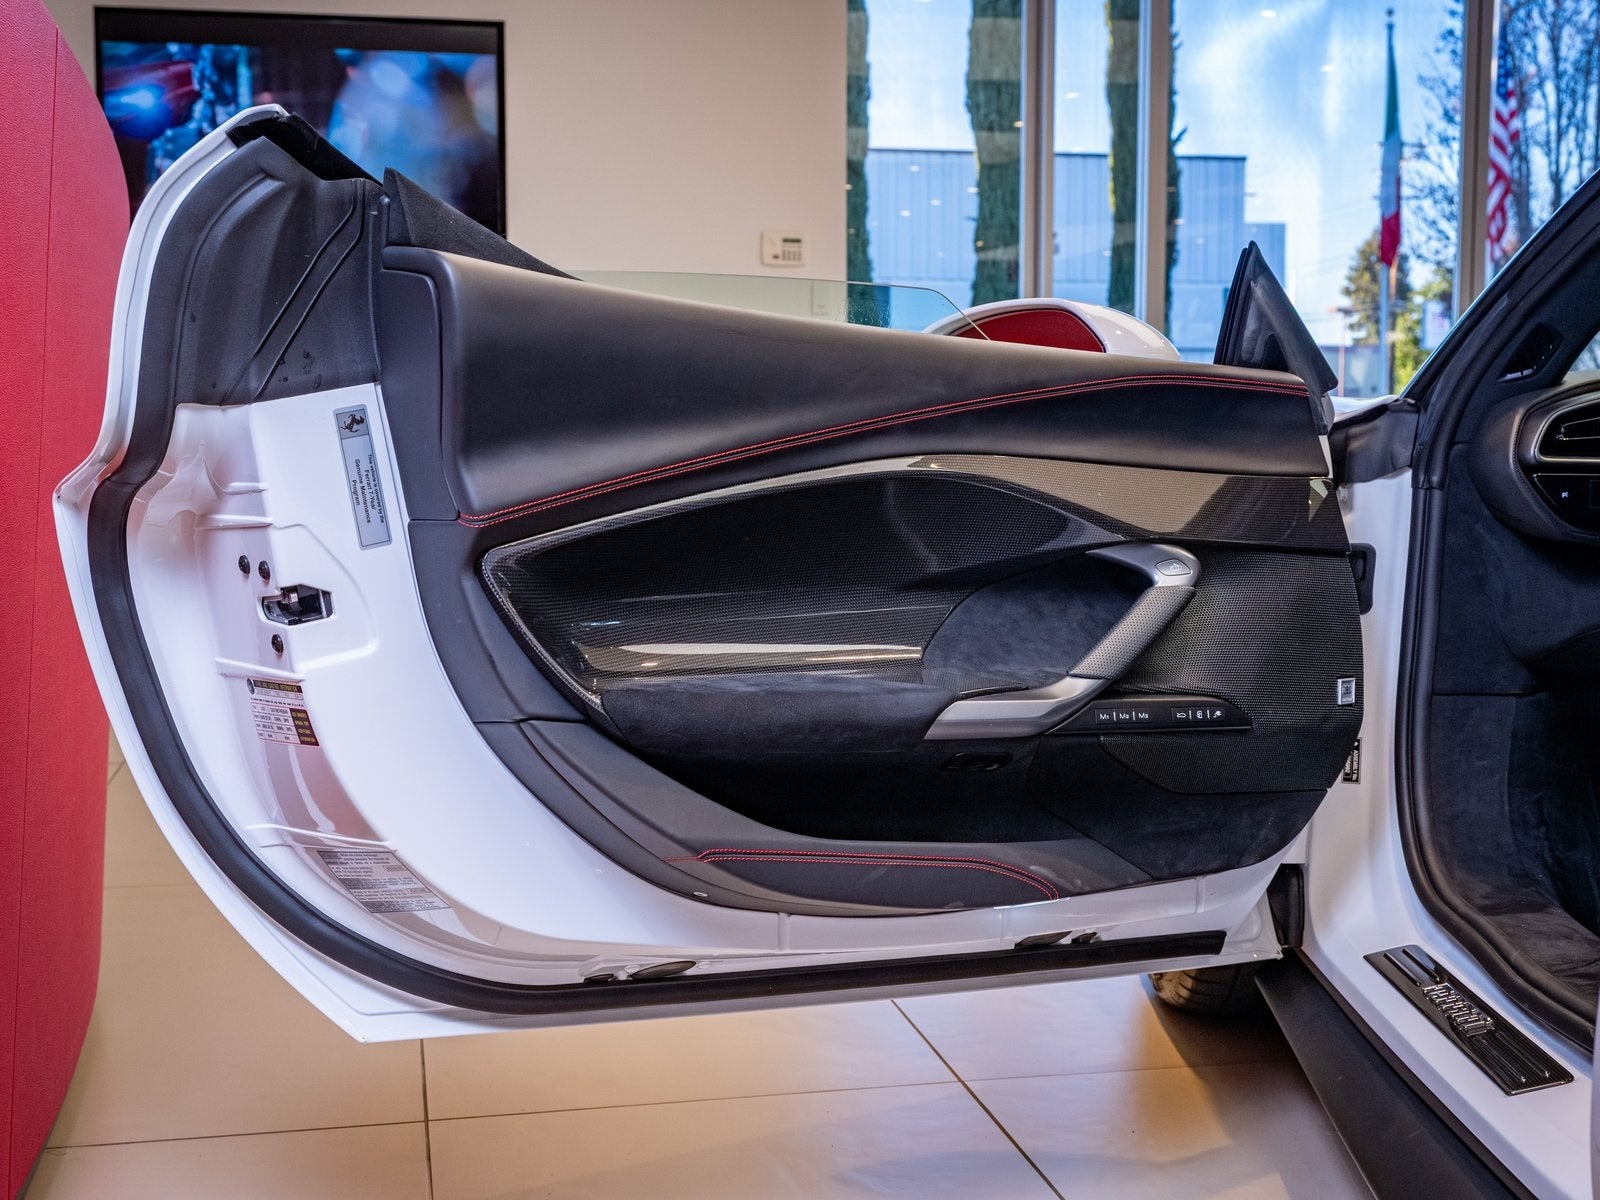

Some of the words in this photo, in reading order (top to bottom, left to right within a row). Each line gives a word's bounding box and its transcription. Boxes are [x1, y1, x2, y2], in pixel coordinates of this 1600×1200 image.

[355, 458, 363, 484] Genuine
[360, 486, 372, 524] Maintenance
[364, 469, 372, 490] Ferrari
[352, 480, 360, 506] Program
